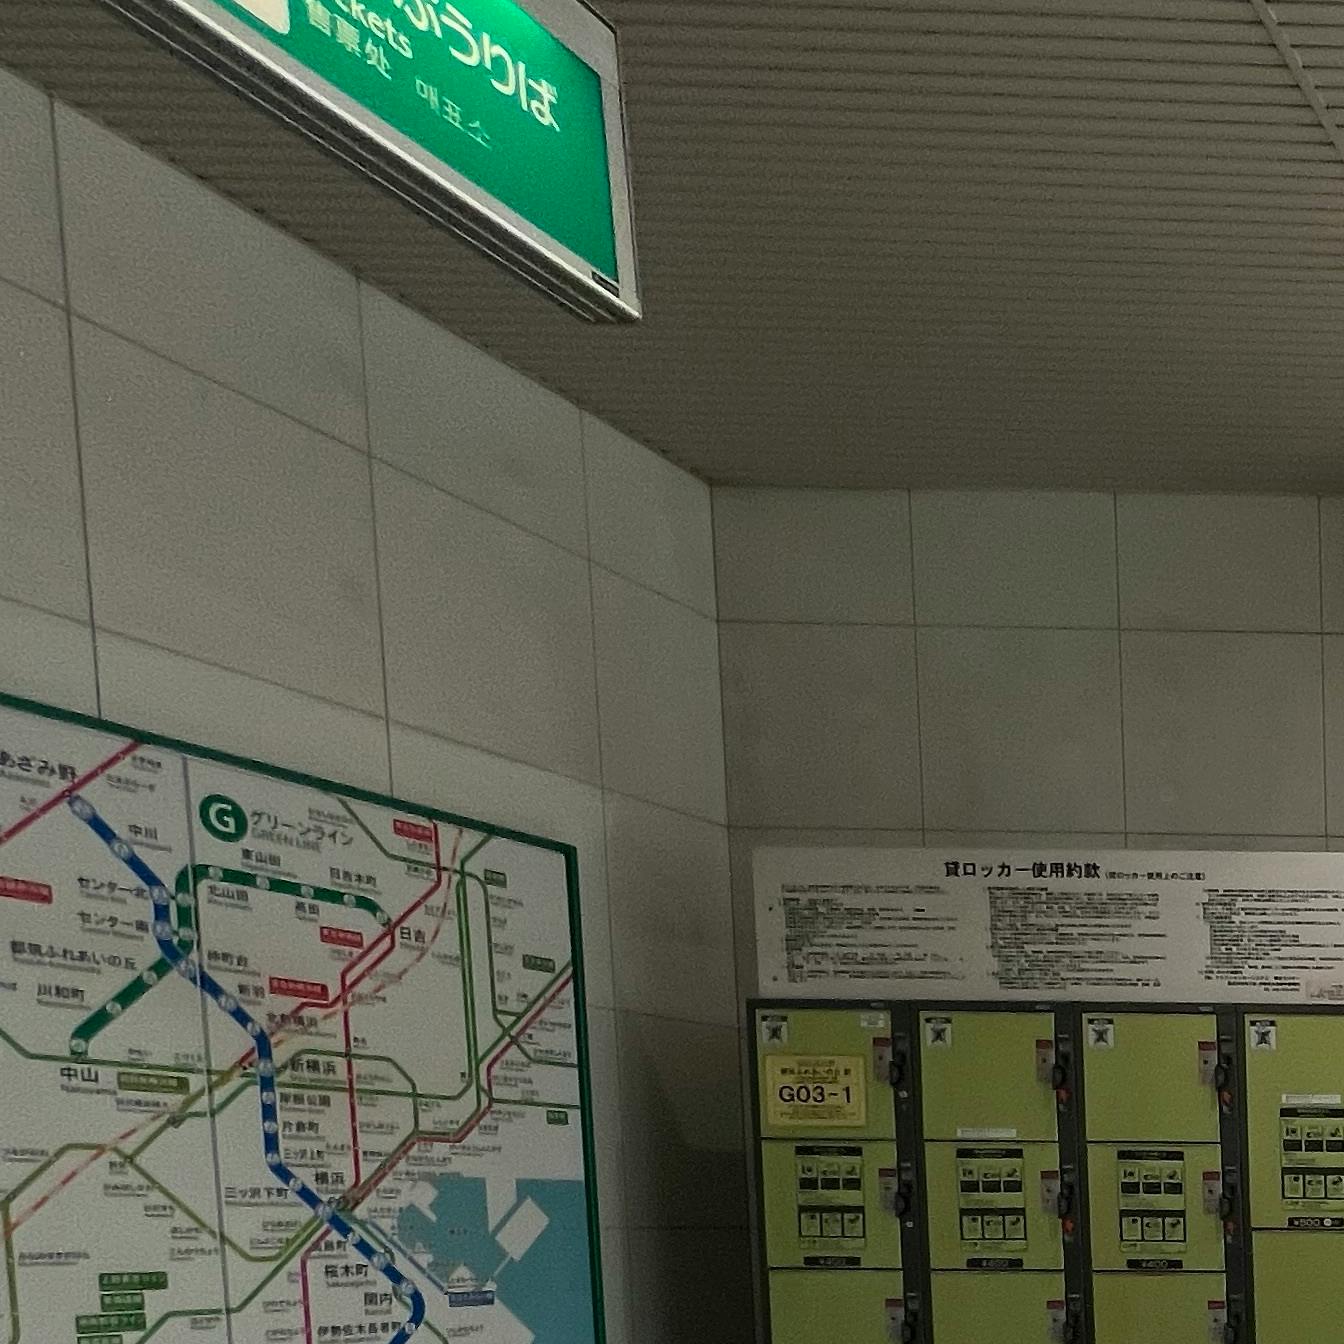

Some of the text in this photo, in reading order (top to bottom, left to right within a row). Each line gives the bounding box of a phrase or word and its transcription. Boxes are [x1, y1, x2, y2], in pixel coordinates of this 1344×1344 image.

[208, 802, 237, 834] G
[944, 861, 1101, 879] 貸ロッカー使用約款
[778, 1085, 852, 1104] G03-1
